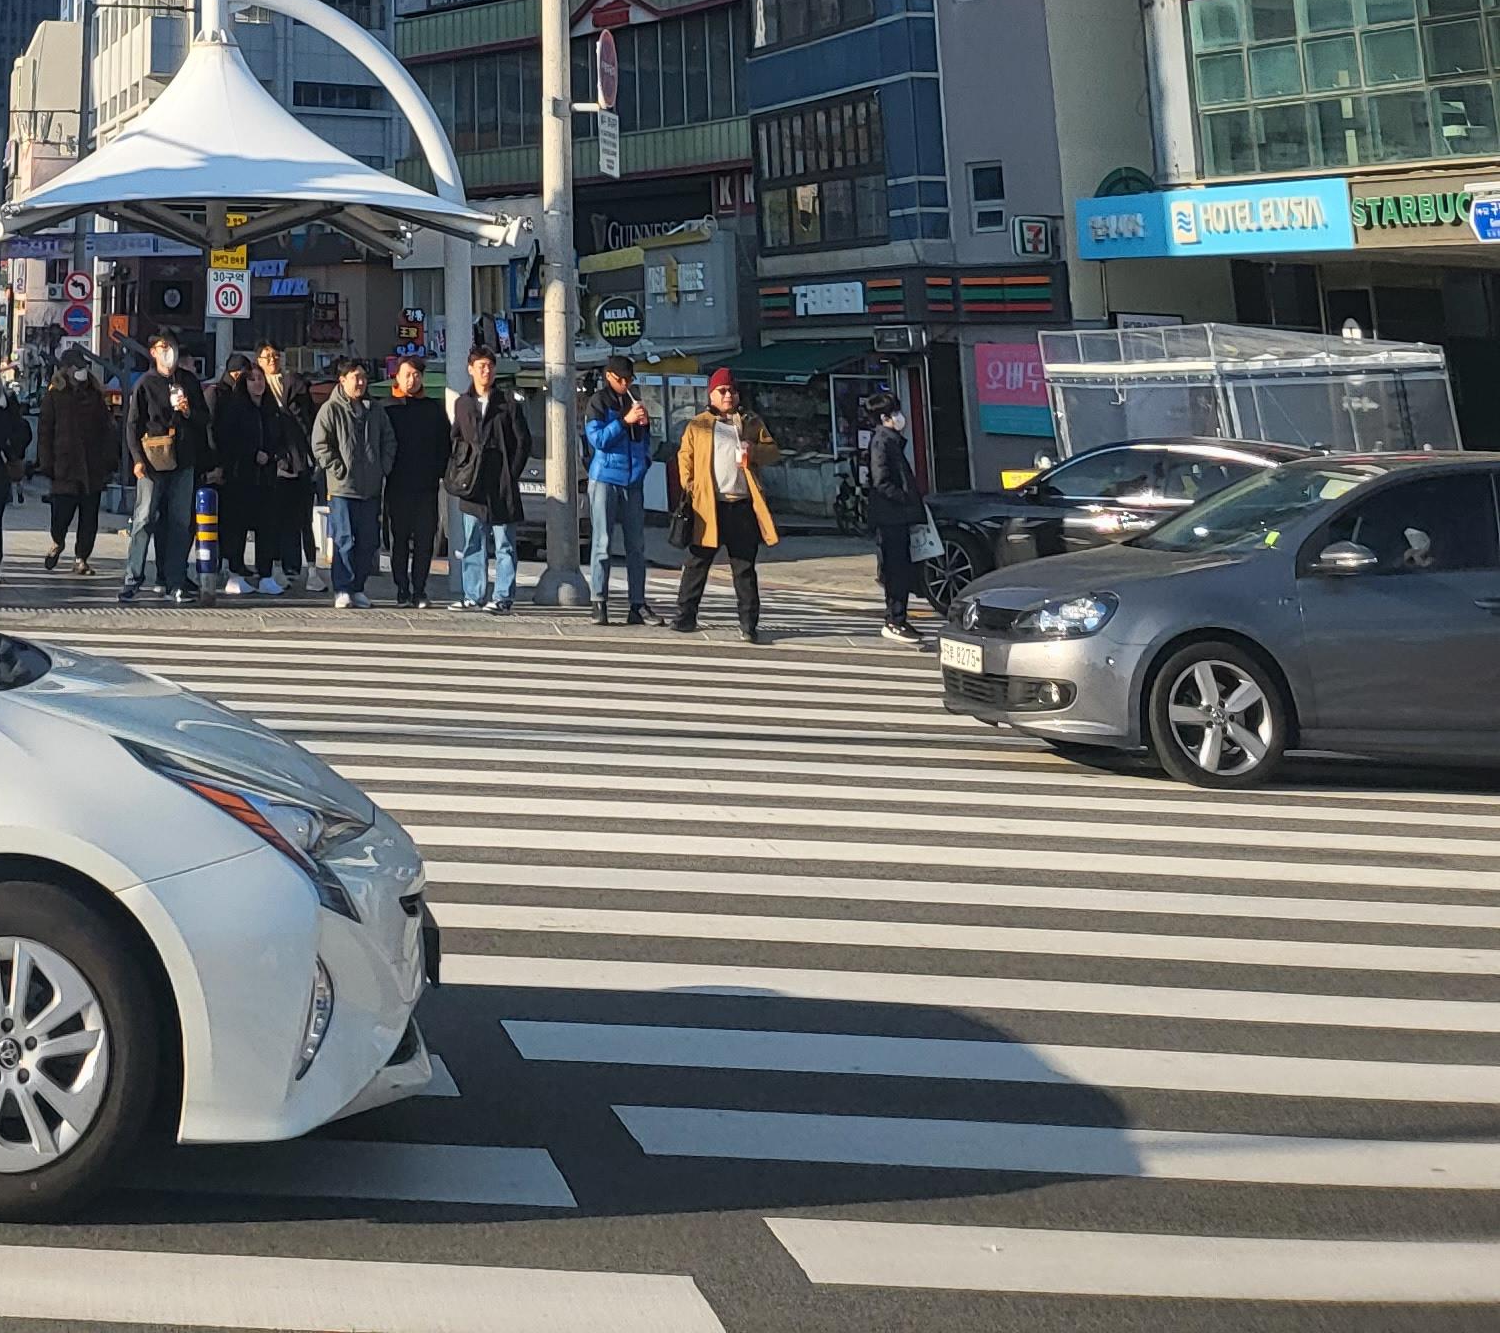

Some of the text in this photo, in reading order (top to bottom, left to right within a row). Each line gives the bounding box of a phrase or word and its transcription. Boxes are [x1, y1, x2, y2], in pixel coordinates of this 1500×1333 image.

[1202, 201, 1255, 233] HOTEL
[213, 271, 244, 283] 30구역
[221, 290, 237, 307] 30
[601, 320, 642, 338] COFFEE
